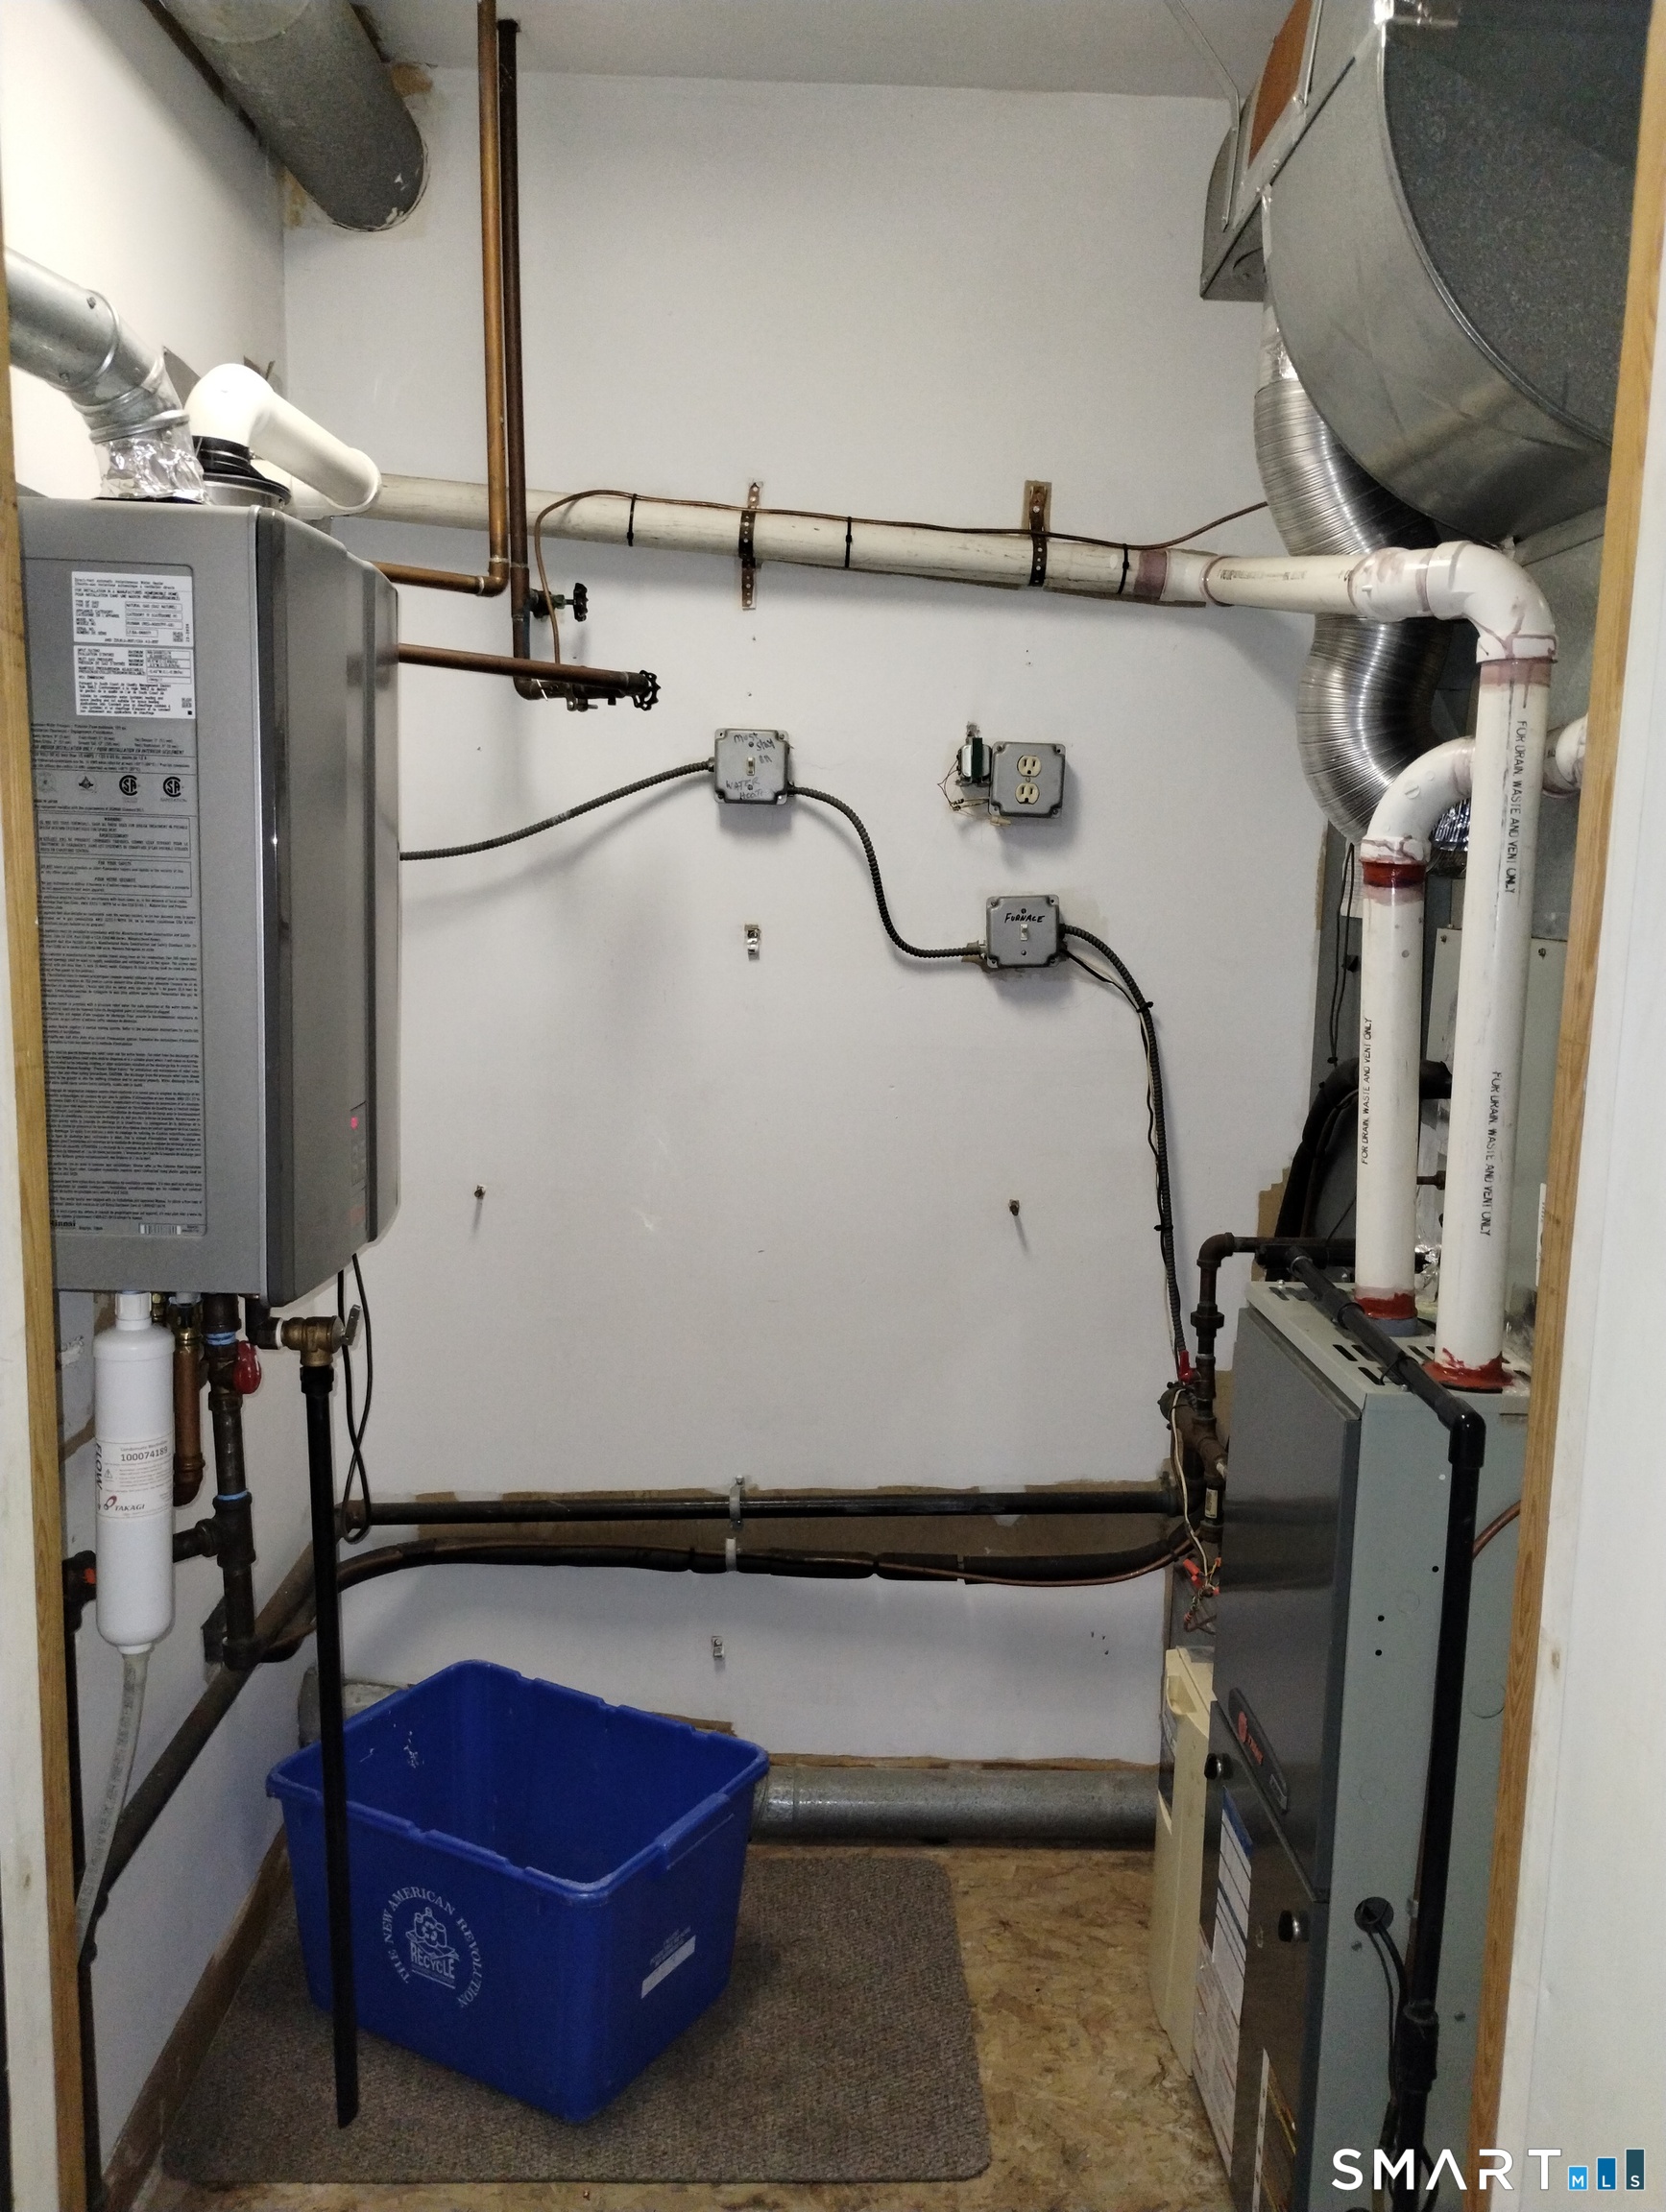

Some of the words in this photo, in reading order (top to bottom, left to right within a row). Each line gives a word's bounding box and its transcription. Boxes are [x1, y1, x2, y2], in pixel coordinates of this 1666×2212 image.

[1514, 720, 1528, 743] FOR
[1509, 780, 1523, 815] WASTE
[1509, 817, 1520, 838] AND
[1505, 868, 1516, 894] ONLY
[1004, 912, 1046, 924] FURNACE
[1363, 1018, 1373, 1040] ONLY
[1363, 1066, 1371, 1084] AND
[1490, 1070, 1503, 1093] FOR
[1362, 1085, 1371, 1115] WASTE
[1361, 1145, 1369, 1166] FOR
[1485, 1128, 1497, 1161] WASTE
[1484, 1164, 1495, 1185] AND
[1480, 1211, 1492, 1238] ONLY
[121, 1446, 168, 1461] 100074189
[388, 1887, 455, 1915] AMERICAN
[382, 1909, 394, 1944] NEW
[388, 1949, 410, 1984] THE
[410, 1941, 455, 1979] RECYCLE
